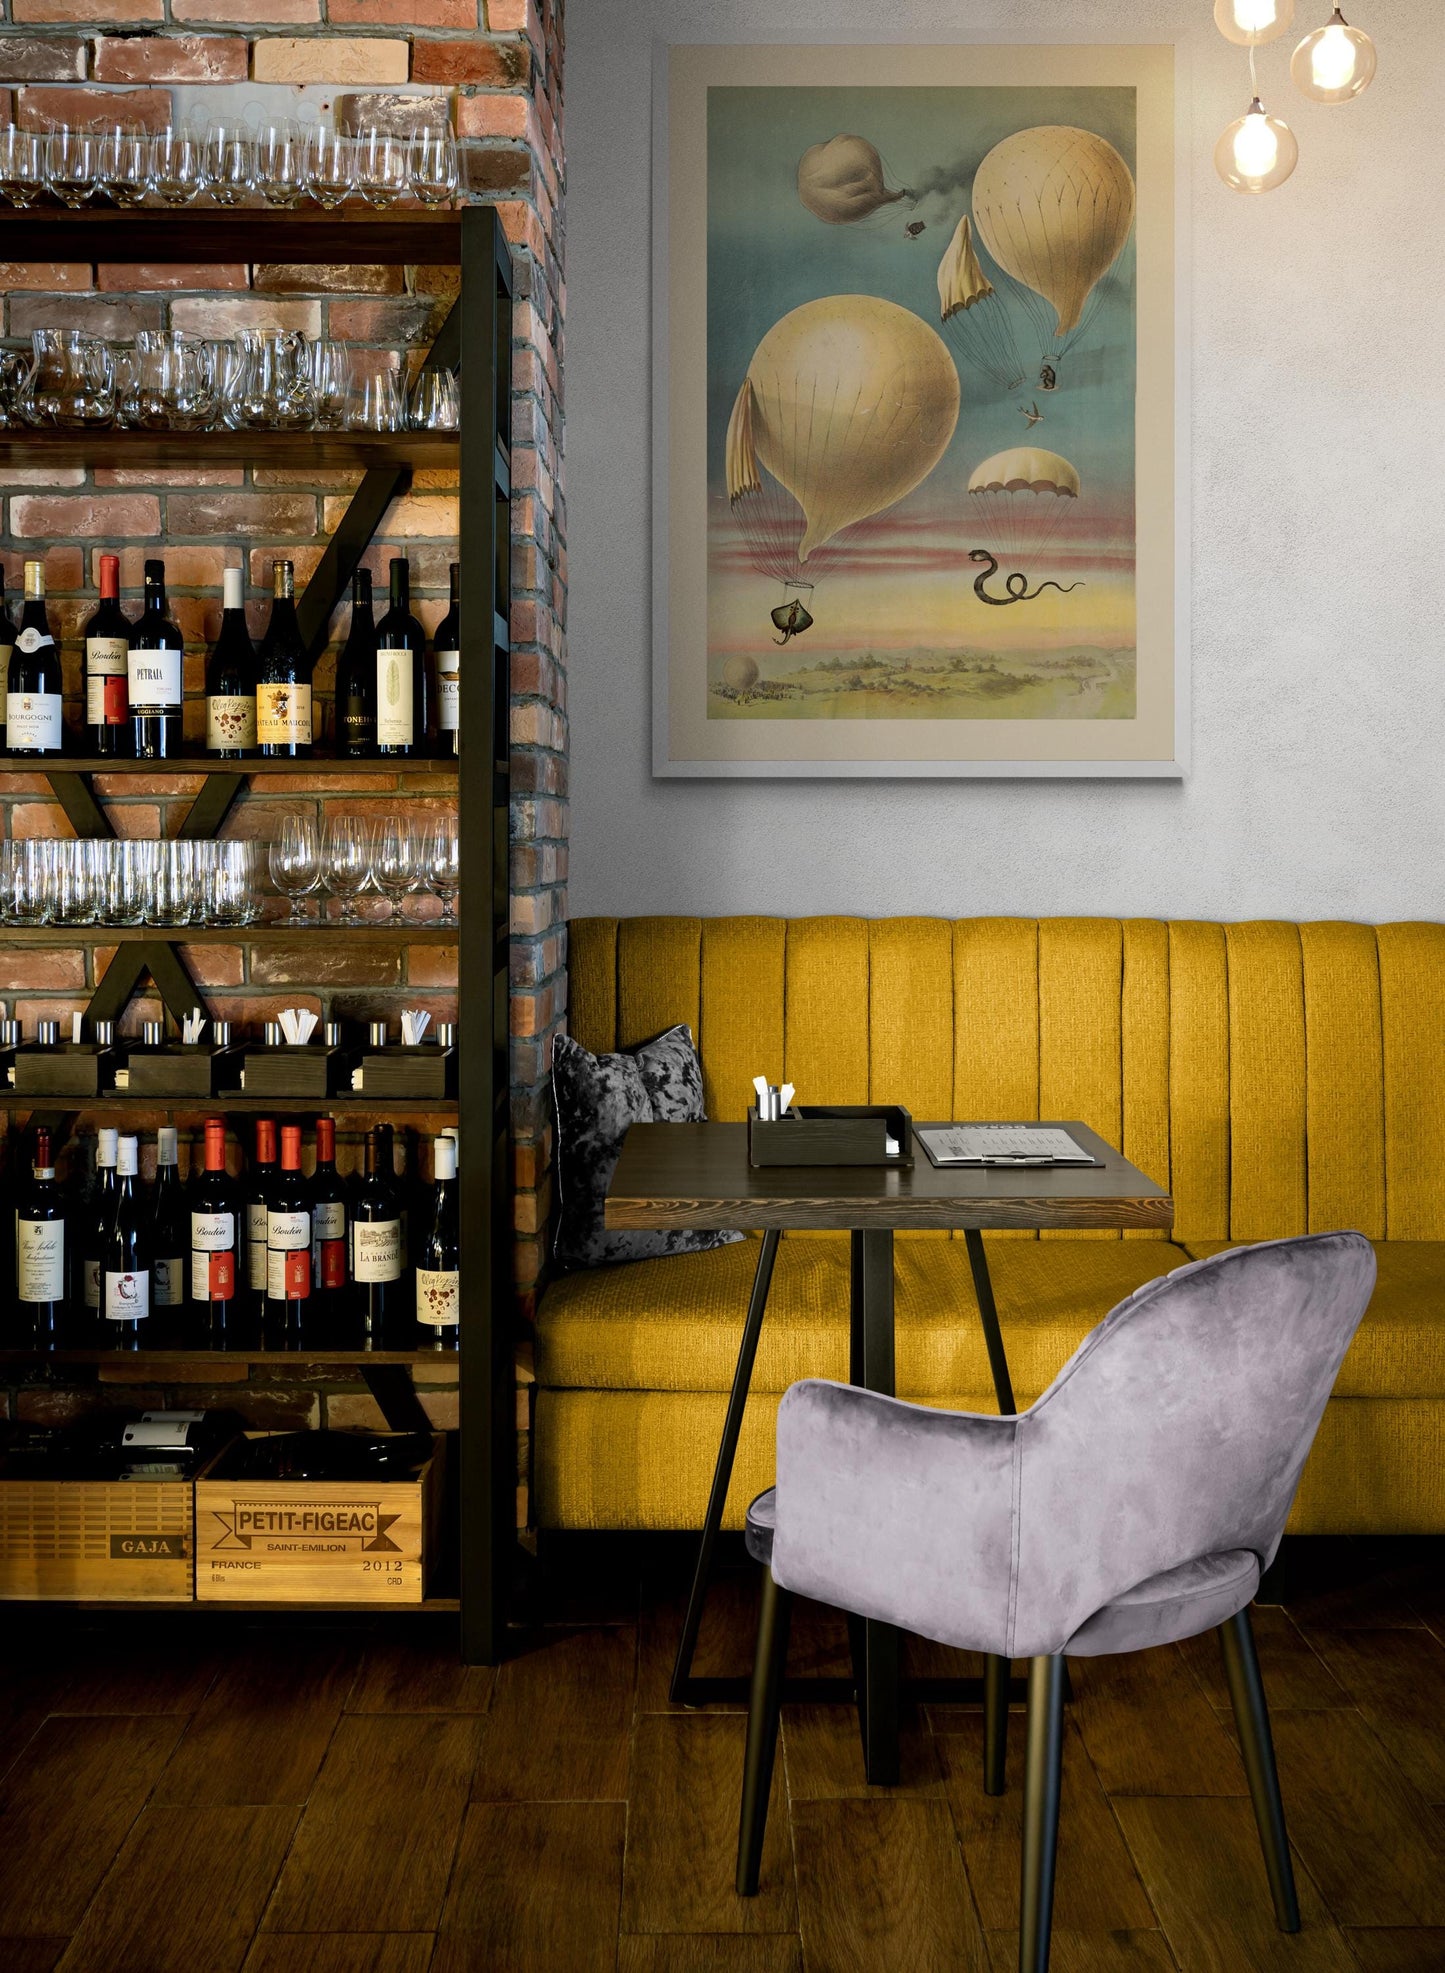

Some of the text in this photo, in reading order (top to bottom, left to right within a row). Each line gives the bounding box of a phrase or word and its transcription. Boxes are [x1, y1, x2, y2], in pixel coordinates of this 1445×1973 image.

[195, 1226, 226, 1236] Bordón
[272, 1225, 303, 1235] Bordón
[239, 1511, 375, 1532] PETIT-FIGEAC
[121, 1540, 172, 1553] GAJA
[267, 1543, 346, 1552] SAINT-EMILION
[211, 1560, 262, 1570] FRANCE
[362, 1560, 403, 1572] 2012
